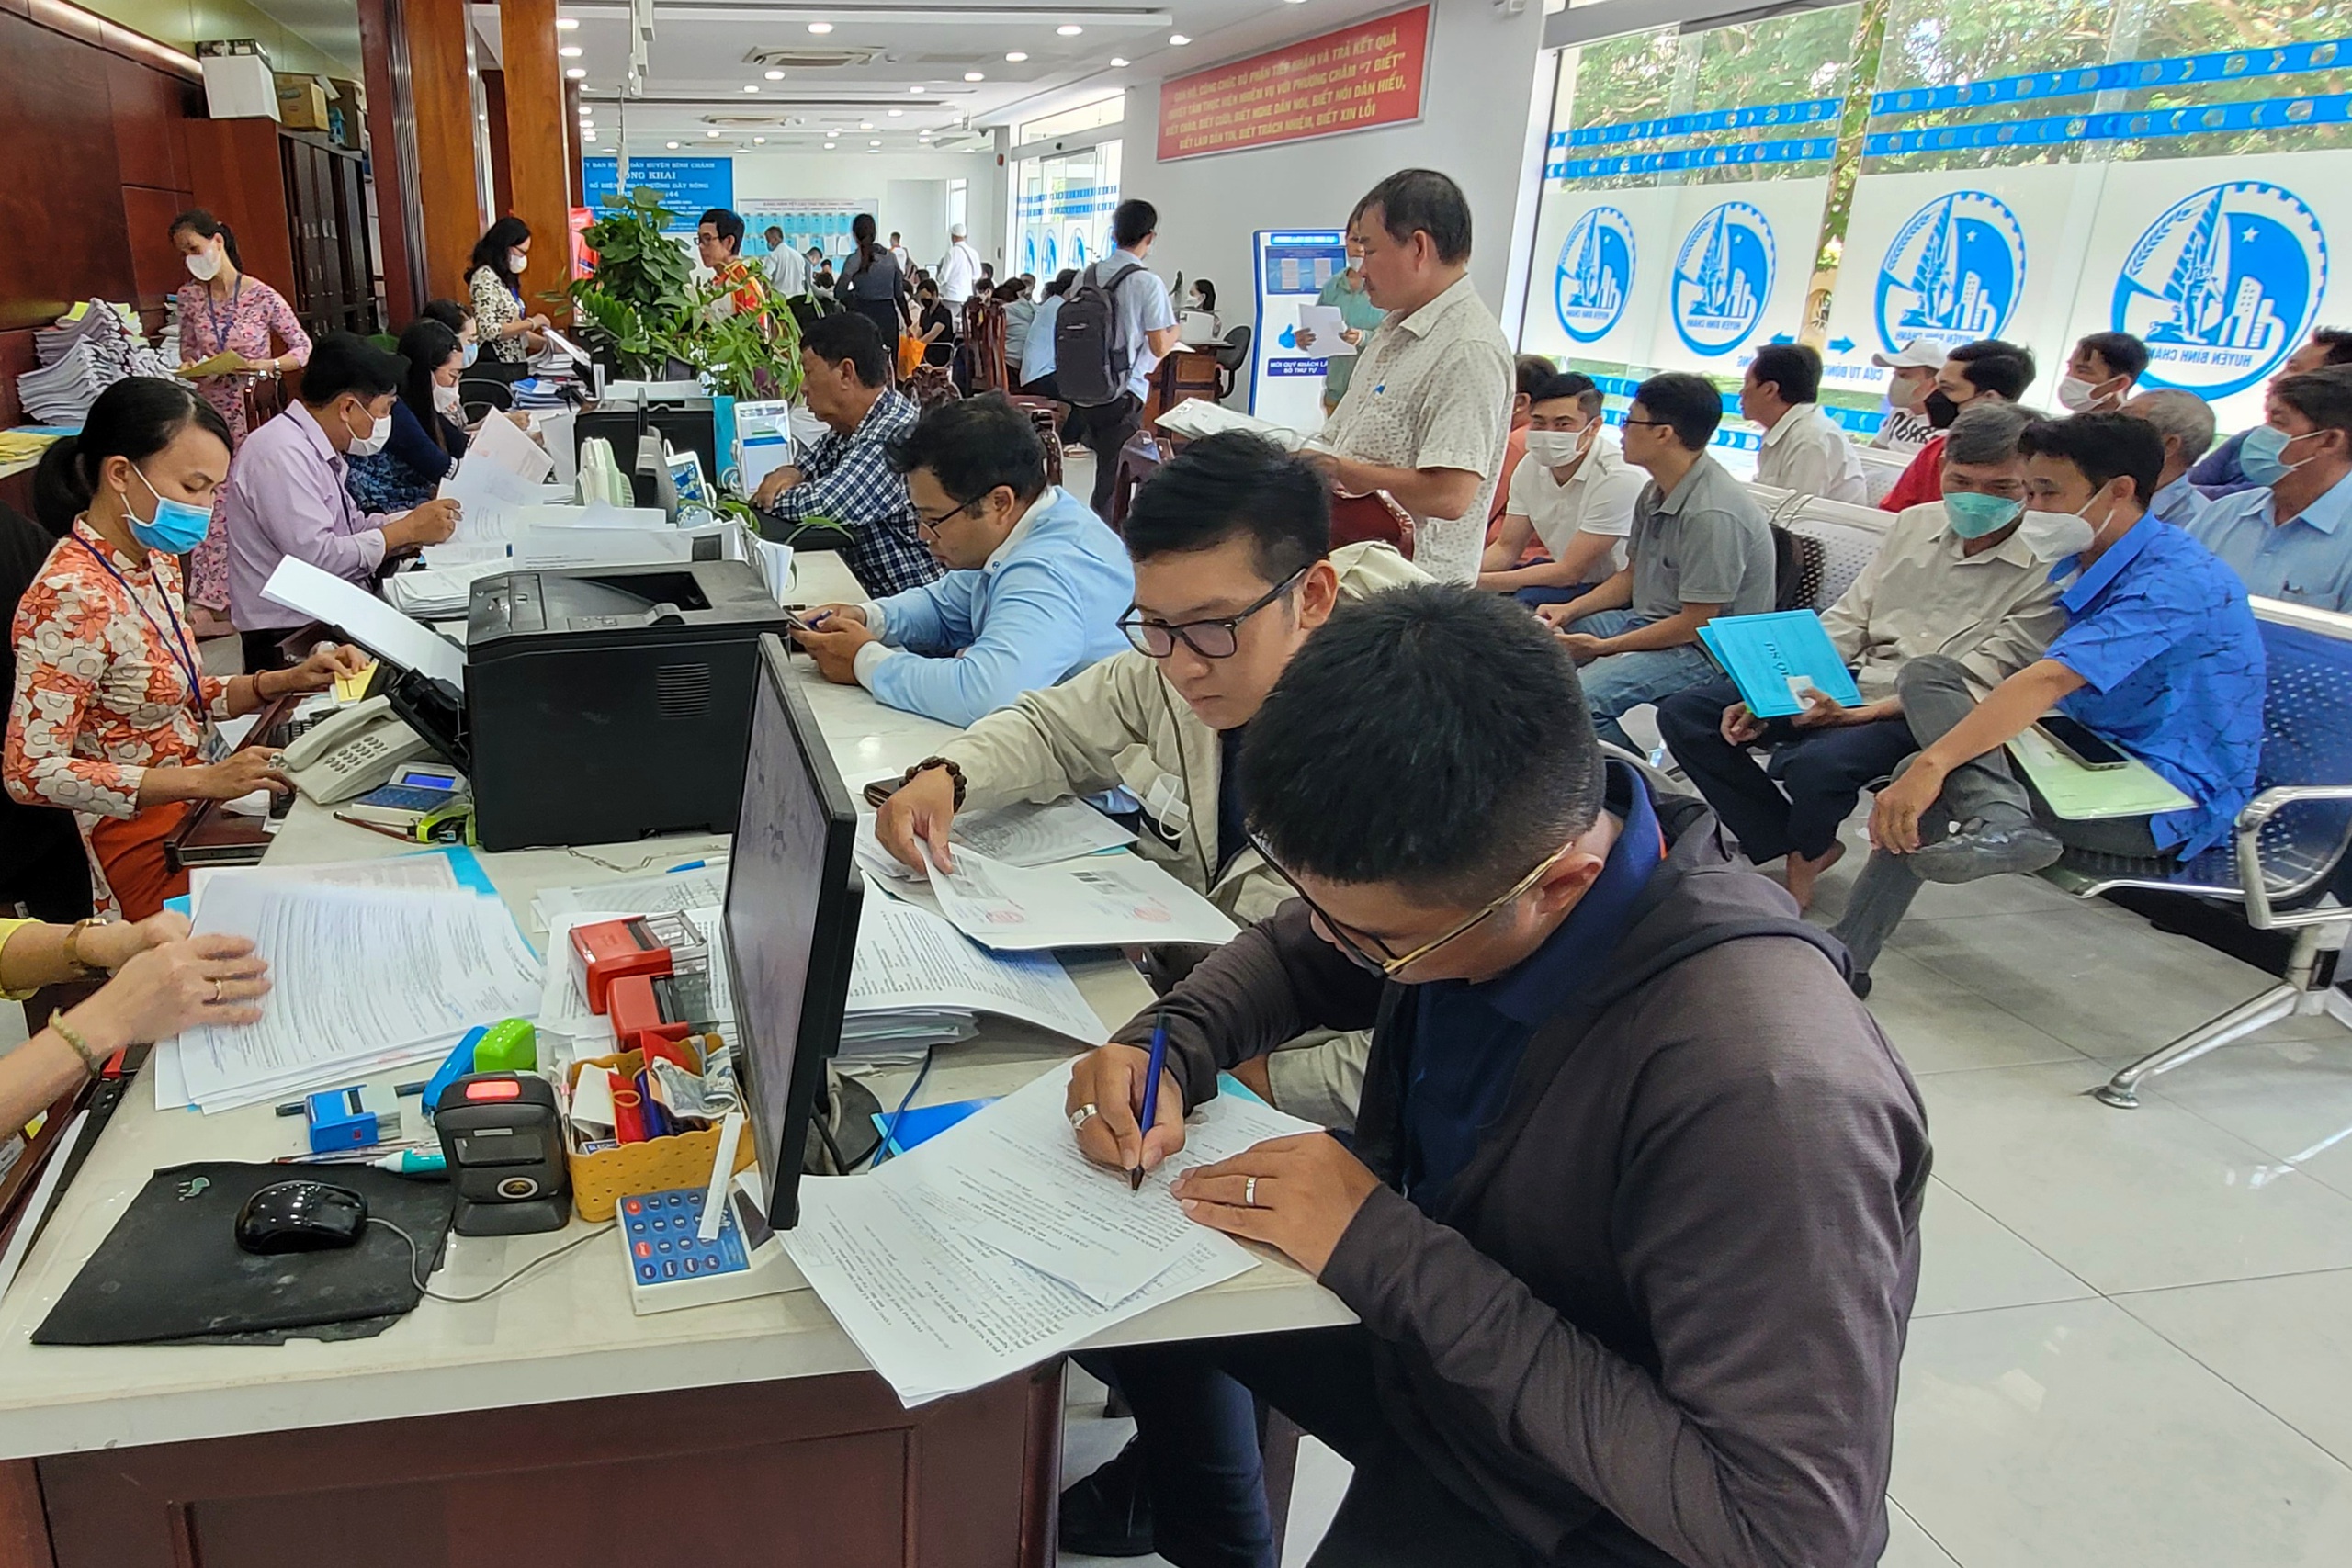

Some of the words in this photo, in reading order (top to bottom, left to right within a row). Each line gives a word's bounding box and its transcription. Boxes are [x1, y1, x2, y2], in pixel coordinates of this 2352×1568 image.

[1317, 48, 1329, 65] VÀ
[1332, 40, 1351, 61] TRẢ
[1352, 35, 1374, 56] KẾT
[1375, 27, 1396, 51] QUẢ
[1312, 87, 1333, 107] BIẾT
[1354, 80, 1375, 98] DÂN
[1378, 70, 1406, 94] HIỂU,
[1316, 107, 1338, 126] BIẾT
[1340, 107, 1357, 121] XIN
[1358, 98, 1376, 118] LỖI
[649, 171, 676, 180] KHAI
